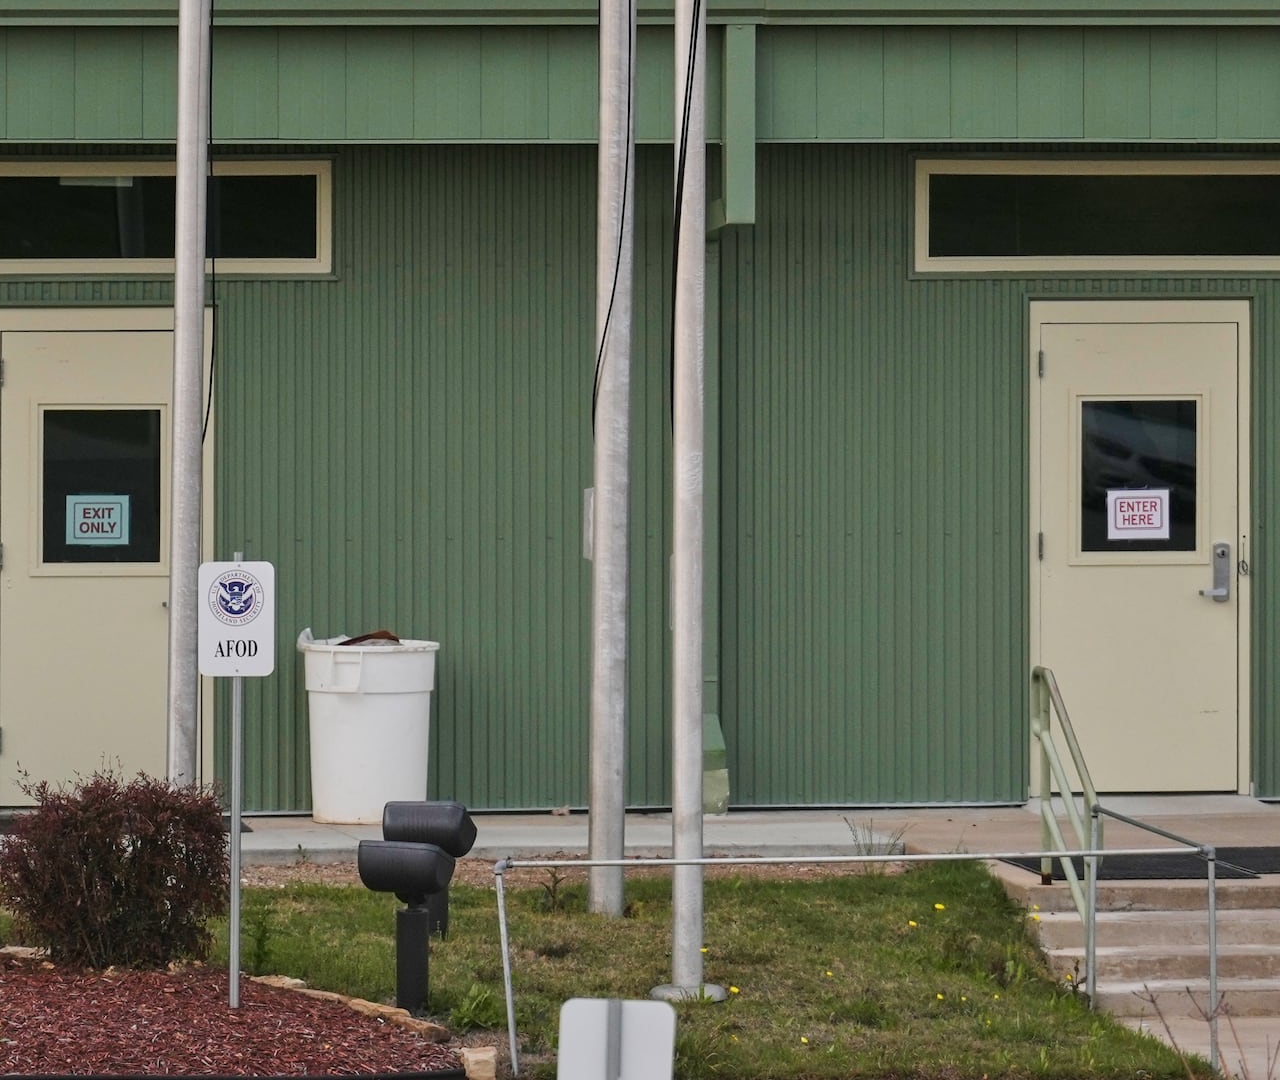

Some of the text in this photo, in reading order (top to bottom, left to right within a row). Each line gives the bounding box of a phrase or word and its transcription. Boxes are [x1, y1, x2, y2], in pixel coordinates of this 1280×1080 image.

[82, 507, 114, 519] EXIT
[1119, 501, 1158, 513] ENTER
[1122, 514, 1154, 525] HERE
[79, 521, 117, 534] ONLY
[214, 639, 258, 658] AFOD
